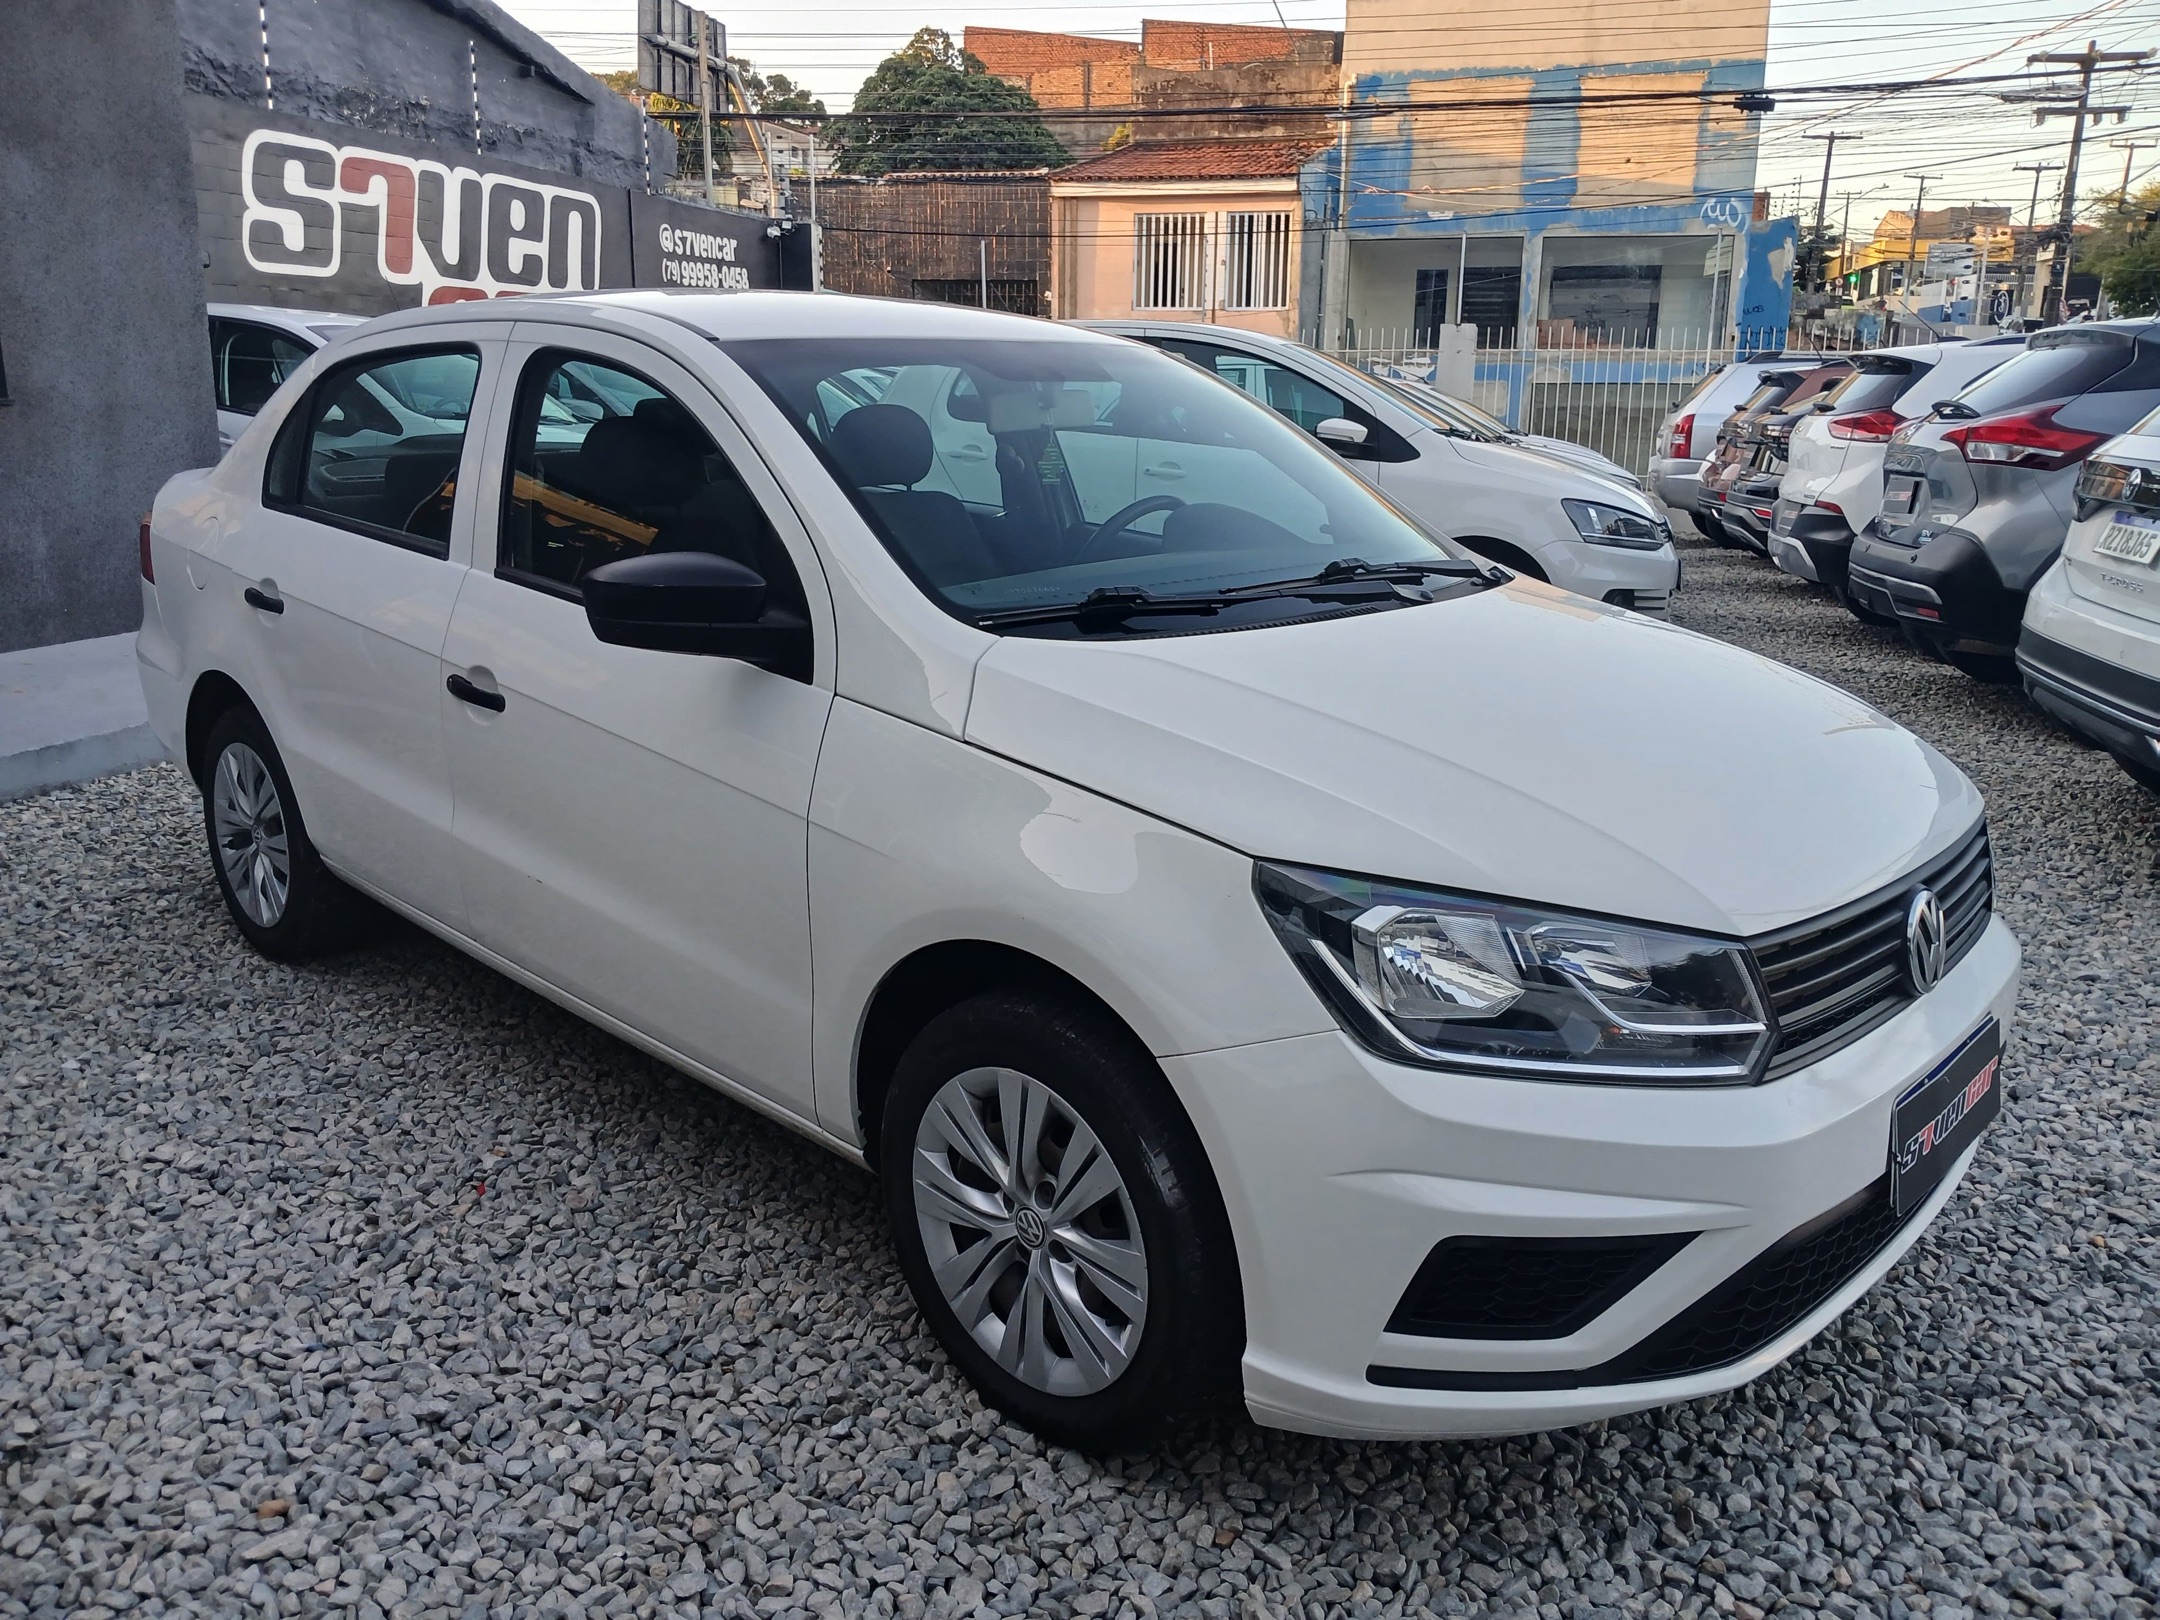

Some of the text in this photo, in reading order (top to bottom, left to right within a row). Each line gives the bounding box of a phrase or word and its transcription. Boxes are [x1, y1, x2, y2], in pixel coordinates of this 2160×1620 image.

[659, 223, 738, 262] @s7vencar
[662, 258, 750, 289] (79) 99958-0458
[2101, 572, 2144, 593] T-CROSS
